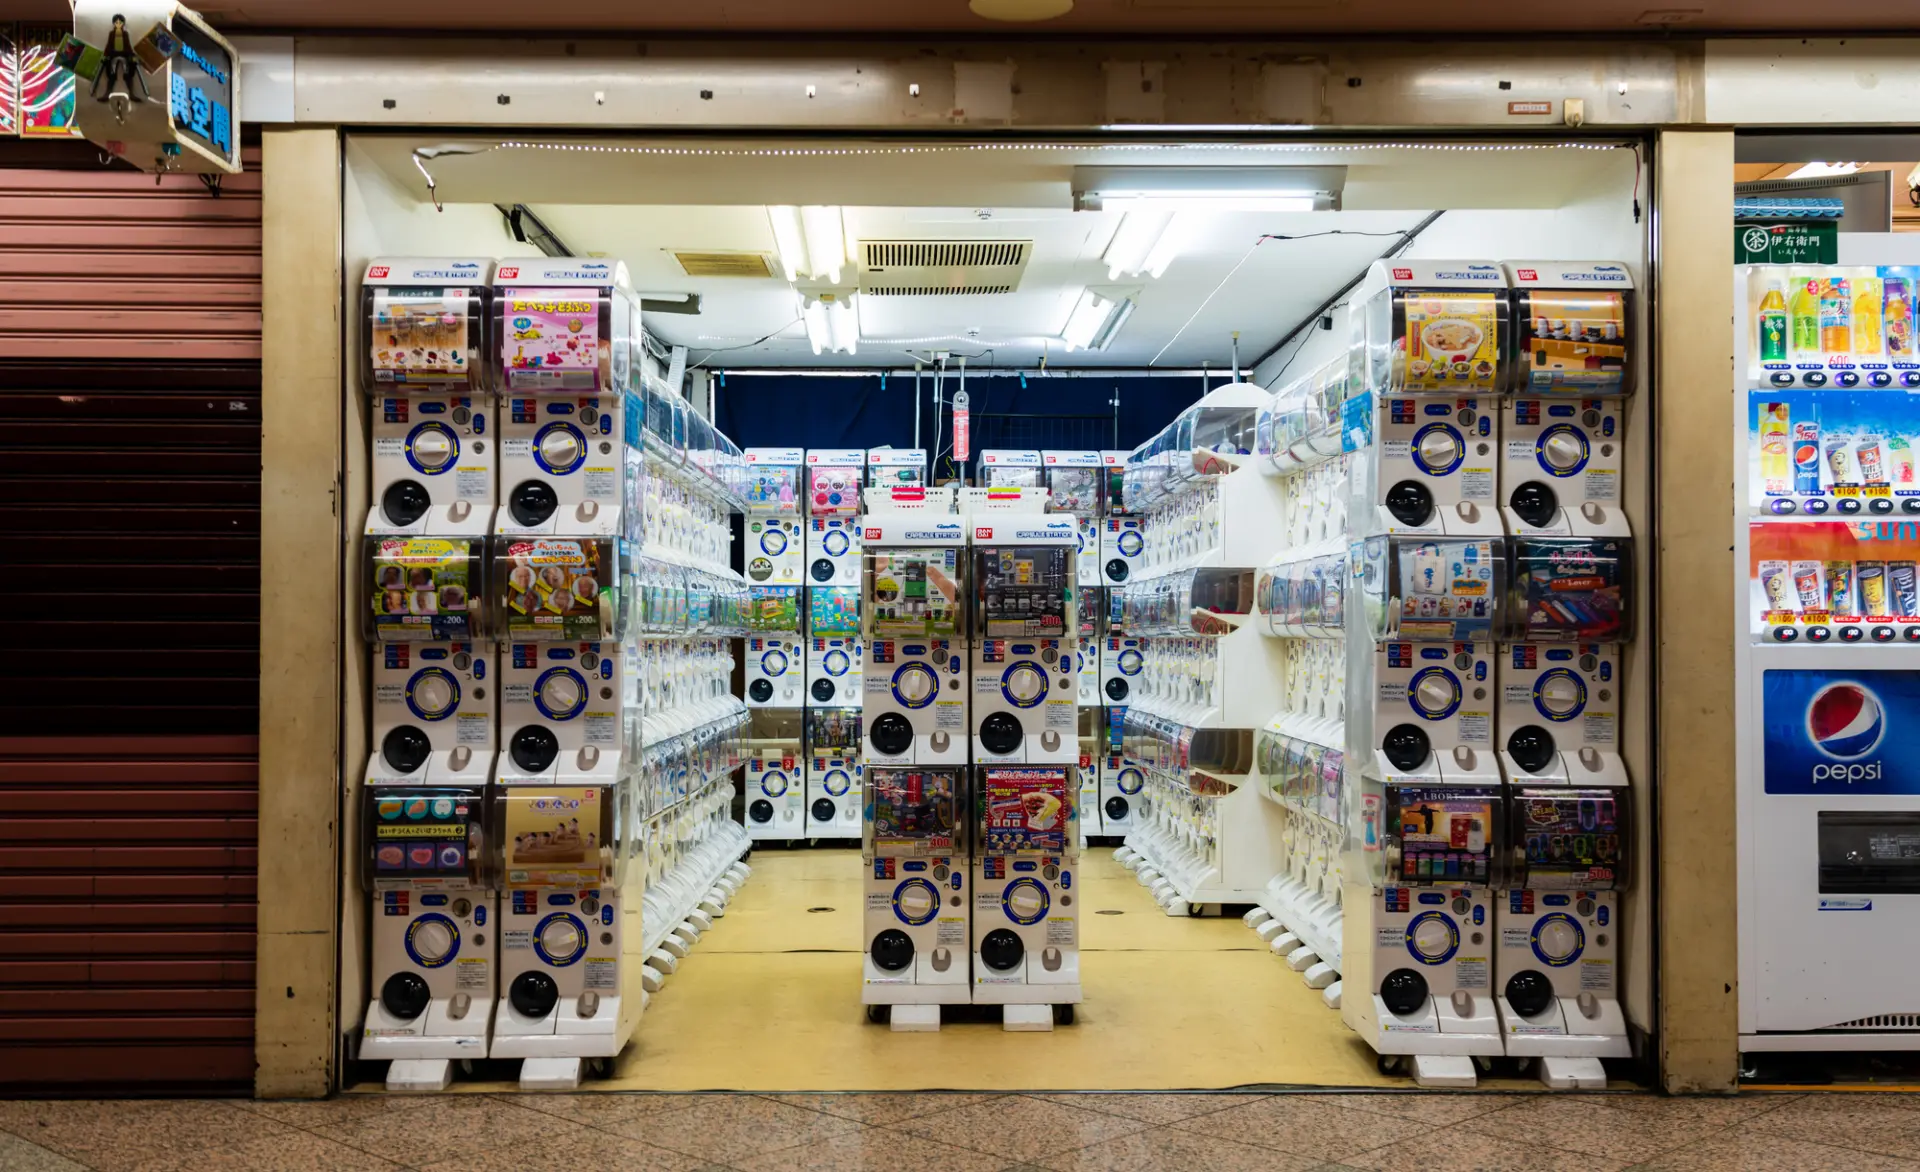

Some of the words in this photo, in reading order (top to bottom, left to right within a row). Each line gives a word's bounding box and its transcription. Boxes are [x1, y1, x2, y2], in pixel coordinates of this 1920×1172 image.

[171, 71, 231, 153] 異空間
[1747, 232, 1765, 249] 茶
[1771, 235, 1820, 247] 伊右衛門
[512, 300, 592, 313] たべっ子どうぶつ
[1858, 521, 1920, 541] sun
[1812, 760, 1882, 784] pepsi
